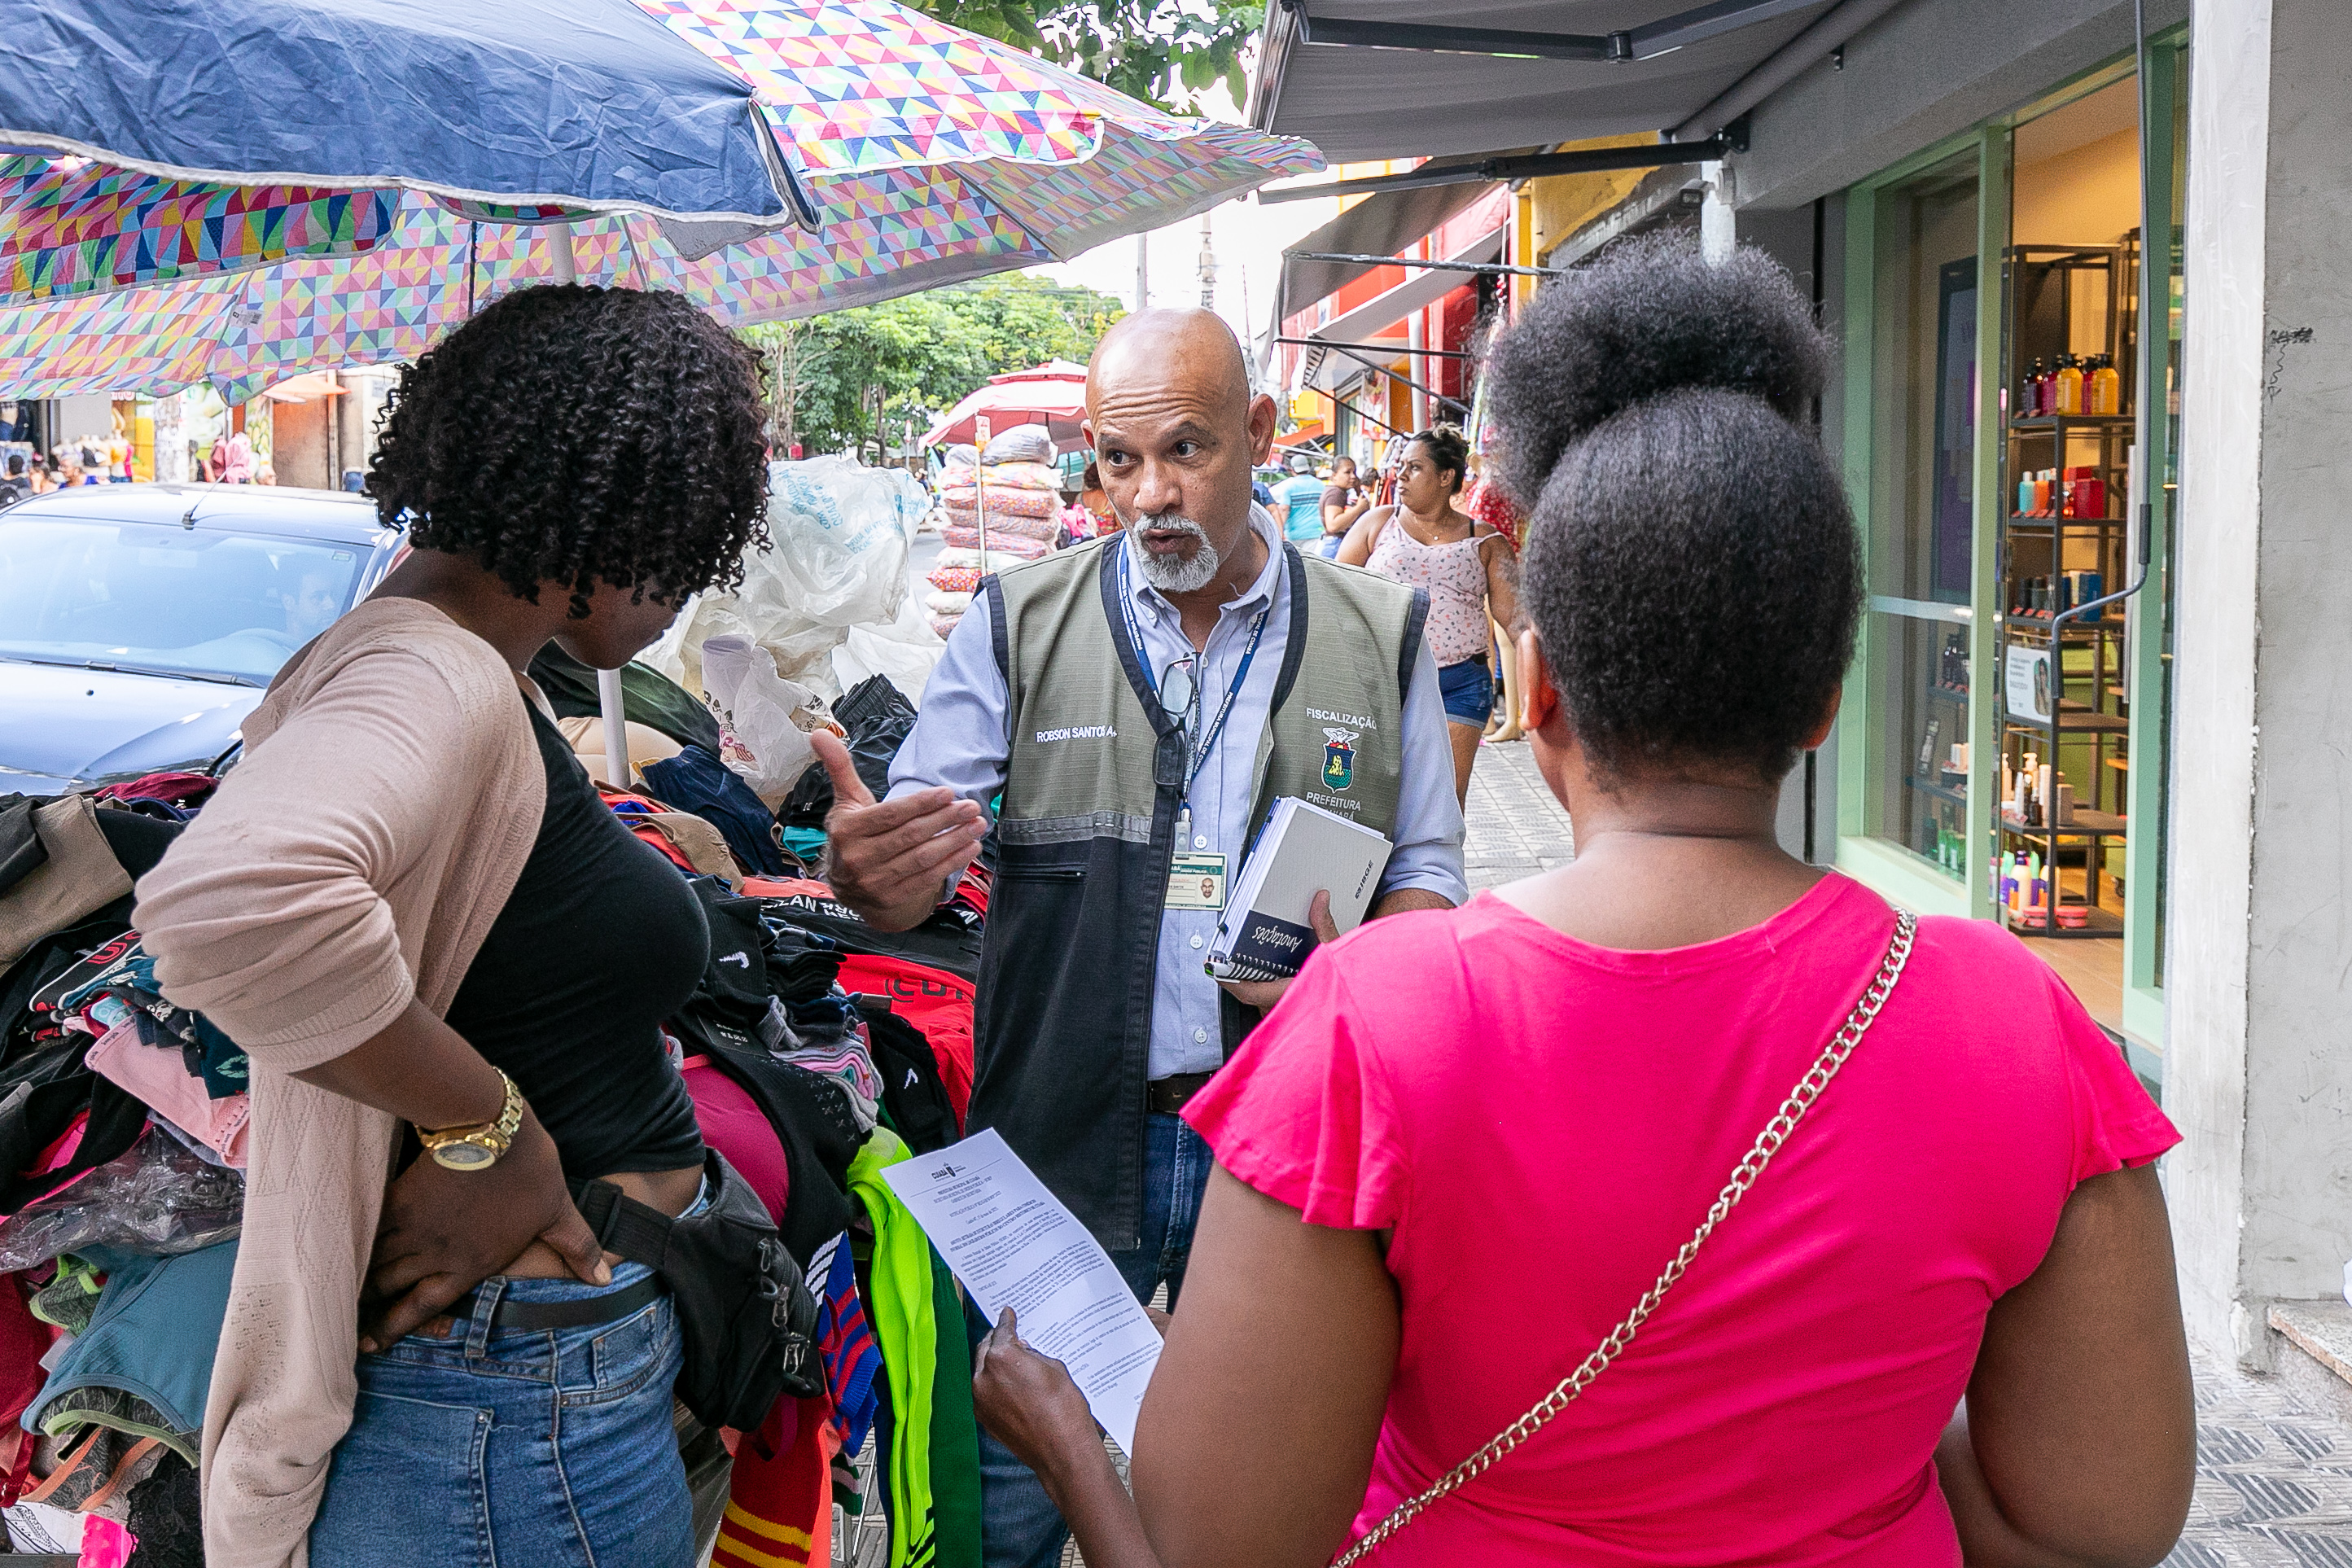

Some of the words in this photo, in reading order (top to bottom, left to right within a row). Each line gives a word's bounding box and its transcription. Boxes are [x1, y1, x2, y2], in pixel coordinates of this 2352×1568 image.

[1216, 691, 1233, 721] PREFEITURA
[1306, 707, 1377, 729] FISCALIZAÇÃO
[1036, 728, 1071, 742] ROBSON
[1071, 725, 1106, 738] SANTOS
[1204, 721, 1220, 747] MUNICIPAL
[1201, 747, 1207, 756] DE
[1306, 791, 1361, 811] PREFEITURA
[1251, 925, 1303, 953] Anotações
